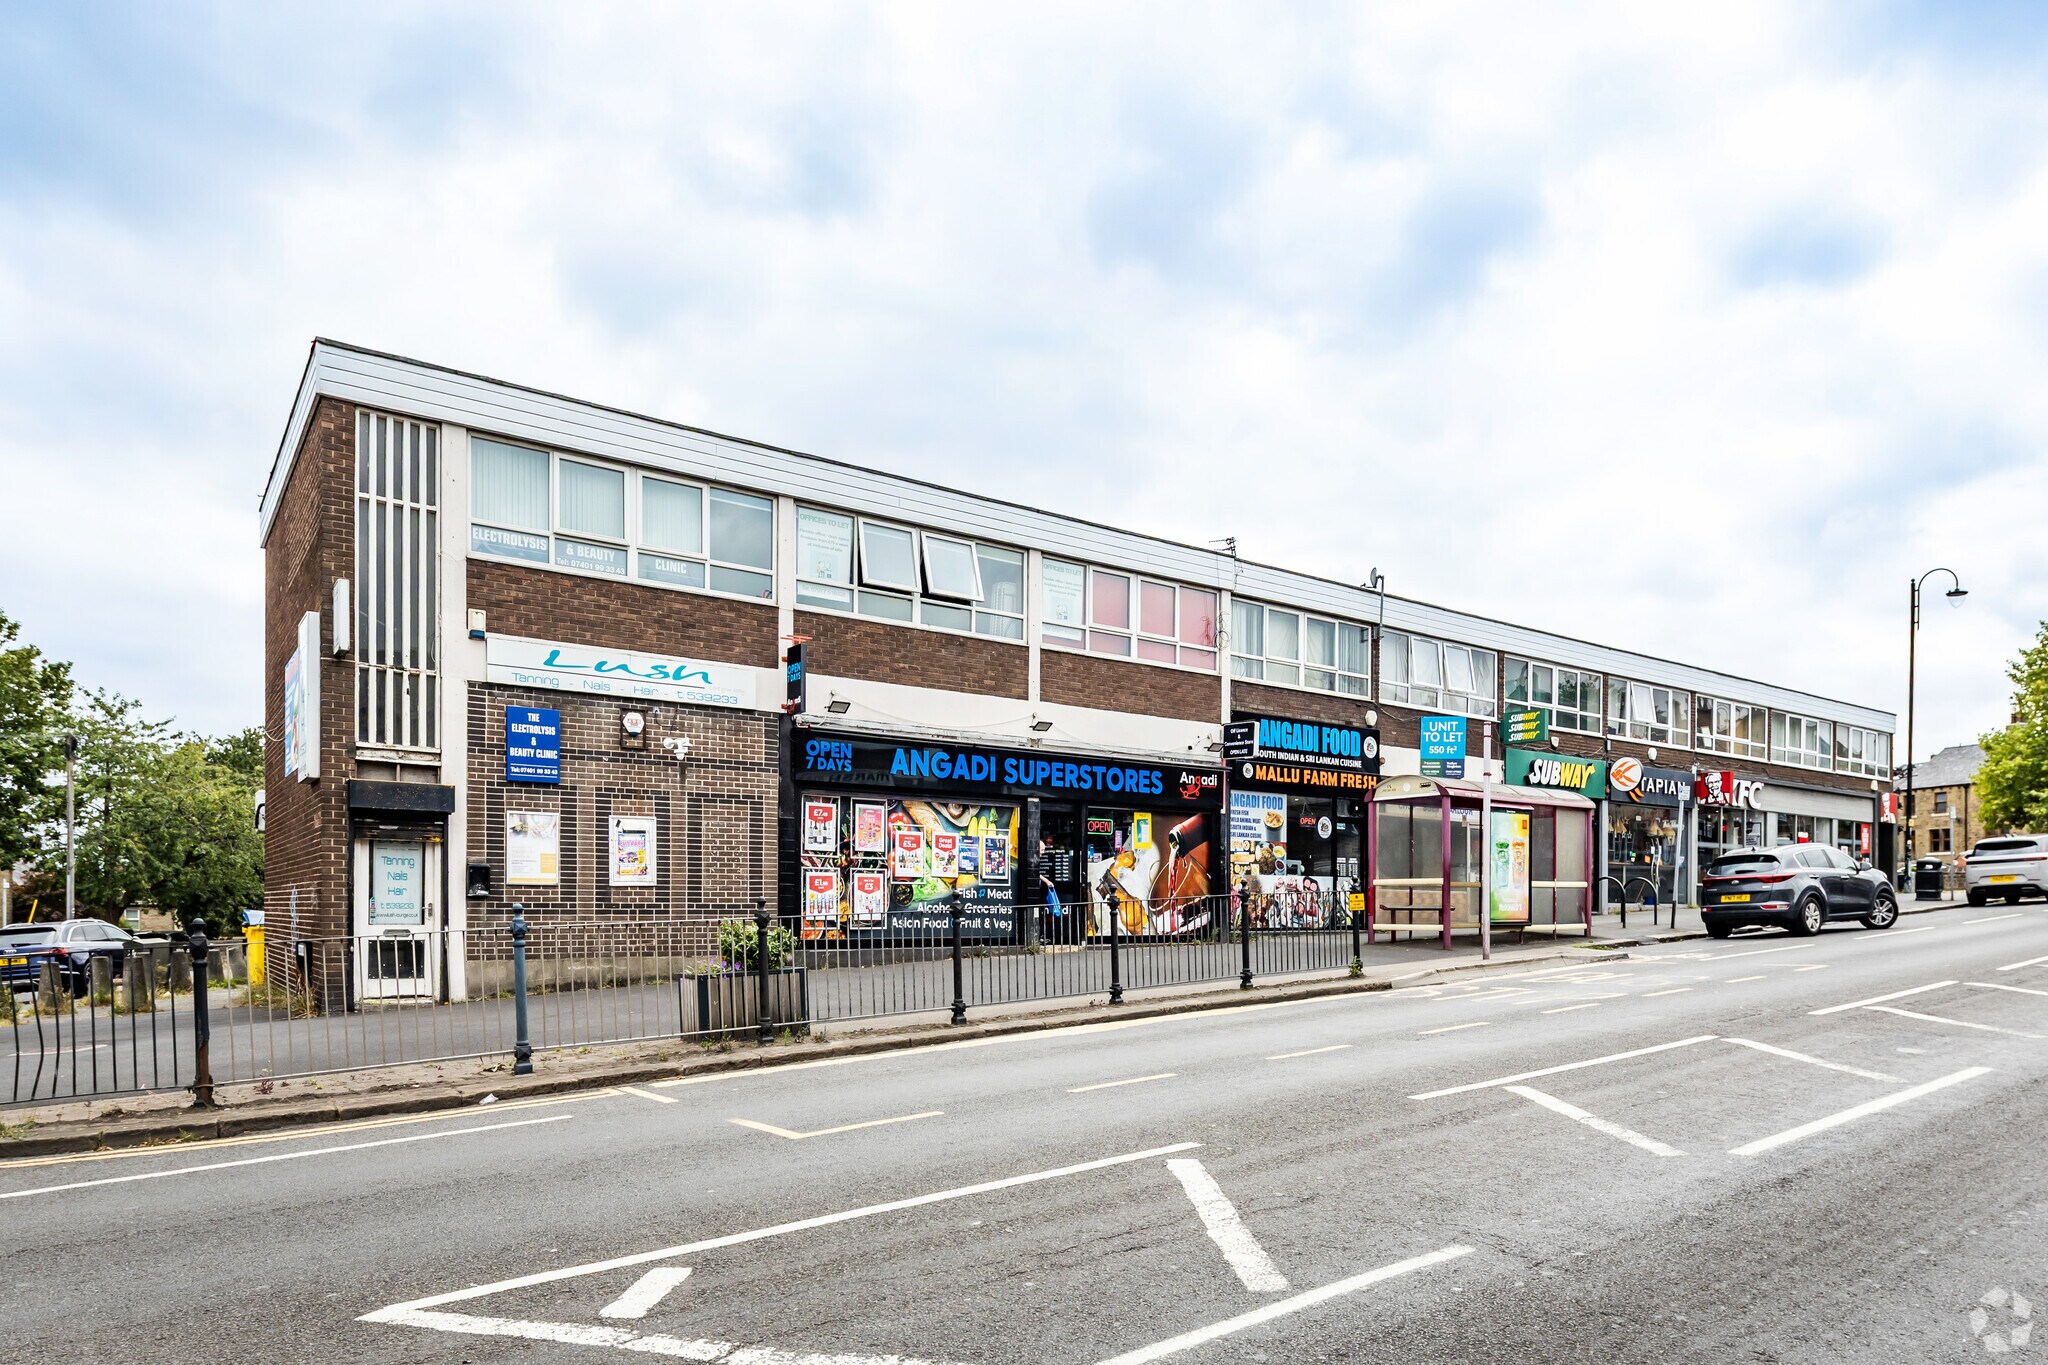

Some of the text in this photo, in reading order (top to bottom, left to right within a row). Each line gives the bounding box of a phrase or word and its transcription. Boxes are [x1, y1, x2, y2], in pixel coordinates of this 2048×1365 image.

[800, 513, 850, 530] OFFICES TO LET
[472, 527, 547, 551] ELECTROLYSIS
[566, 544, 615, 563] & BEAUTY
[556, 557, 569, 567] Tel:
[571, 559, 593, 571] 07401
[655, 559, 687, 575] CLINIC
[1044, 563, 1064, 573] OFFICES
[543, 649, 713, 685] Lush
[787, 662, 801, 673] OPEN
[511, 672, 560, 688] Tanning
[583, 680, 611, 692] Nails
[633, 685, 659, 696] Hair
[686, 692, 738, 705] 539233
[527, 712, 540, 723] THE
[1508, 711, 1540, 723] SUBWAY
[512, 723, 556, 736] ELECTROLYSIS
[1429, 721, 1458, 732] UNIT
[1508, 721, 1540, 732] SUBWAY
[530, 737, 537, 746] &
[1259, 718, 1361, 757] ANGADI FOOD
[1423, 732, 1464, 742] TO LET
[1508, 730, 1540, 742] SUBWAY
[510, 747, 558, 760] BEAUTY CLINIC
[806, 740, 852, 758] OPEN
[1428, 746, 1445, 754] 550
[806, 756, 852, 772] 7 DAYS
[1278, 752, 1299, 762] INDIAN
[1300, 754, 1305, 762] &
[1306, 754, 1315, 764] SRI
[1316, 756, 1340, 766] LANKAN
[1340, 758, 1362, 768] CUISINE
[889, 748, 1164, 795] ANGADI SUPERSTORES
[1255, 764, 1300, 784] MALLU
[1303, 770, 1338, 787] FARM
[1340, 773, 1378, 790] FRESH
[1528, 758, 1596, 789] SUBWAY
[1180, 772, 1218, 787] Angadi
[1262, 796, 1283, 810] FOOD
[1088, 820, 1111, 832] OPEN
[381, 856, 415, 868] Tanning
[388, 870, 408, 881] Nails
[388, 886, 408, 896] Hair
[987, 888, 1012, 900] Meat
[386, 902, 414, 910] 539233
[964, 902, 1012, 914] Groceries
[892, 916, 1012, 932] Asian Food Fruit & Veg
